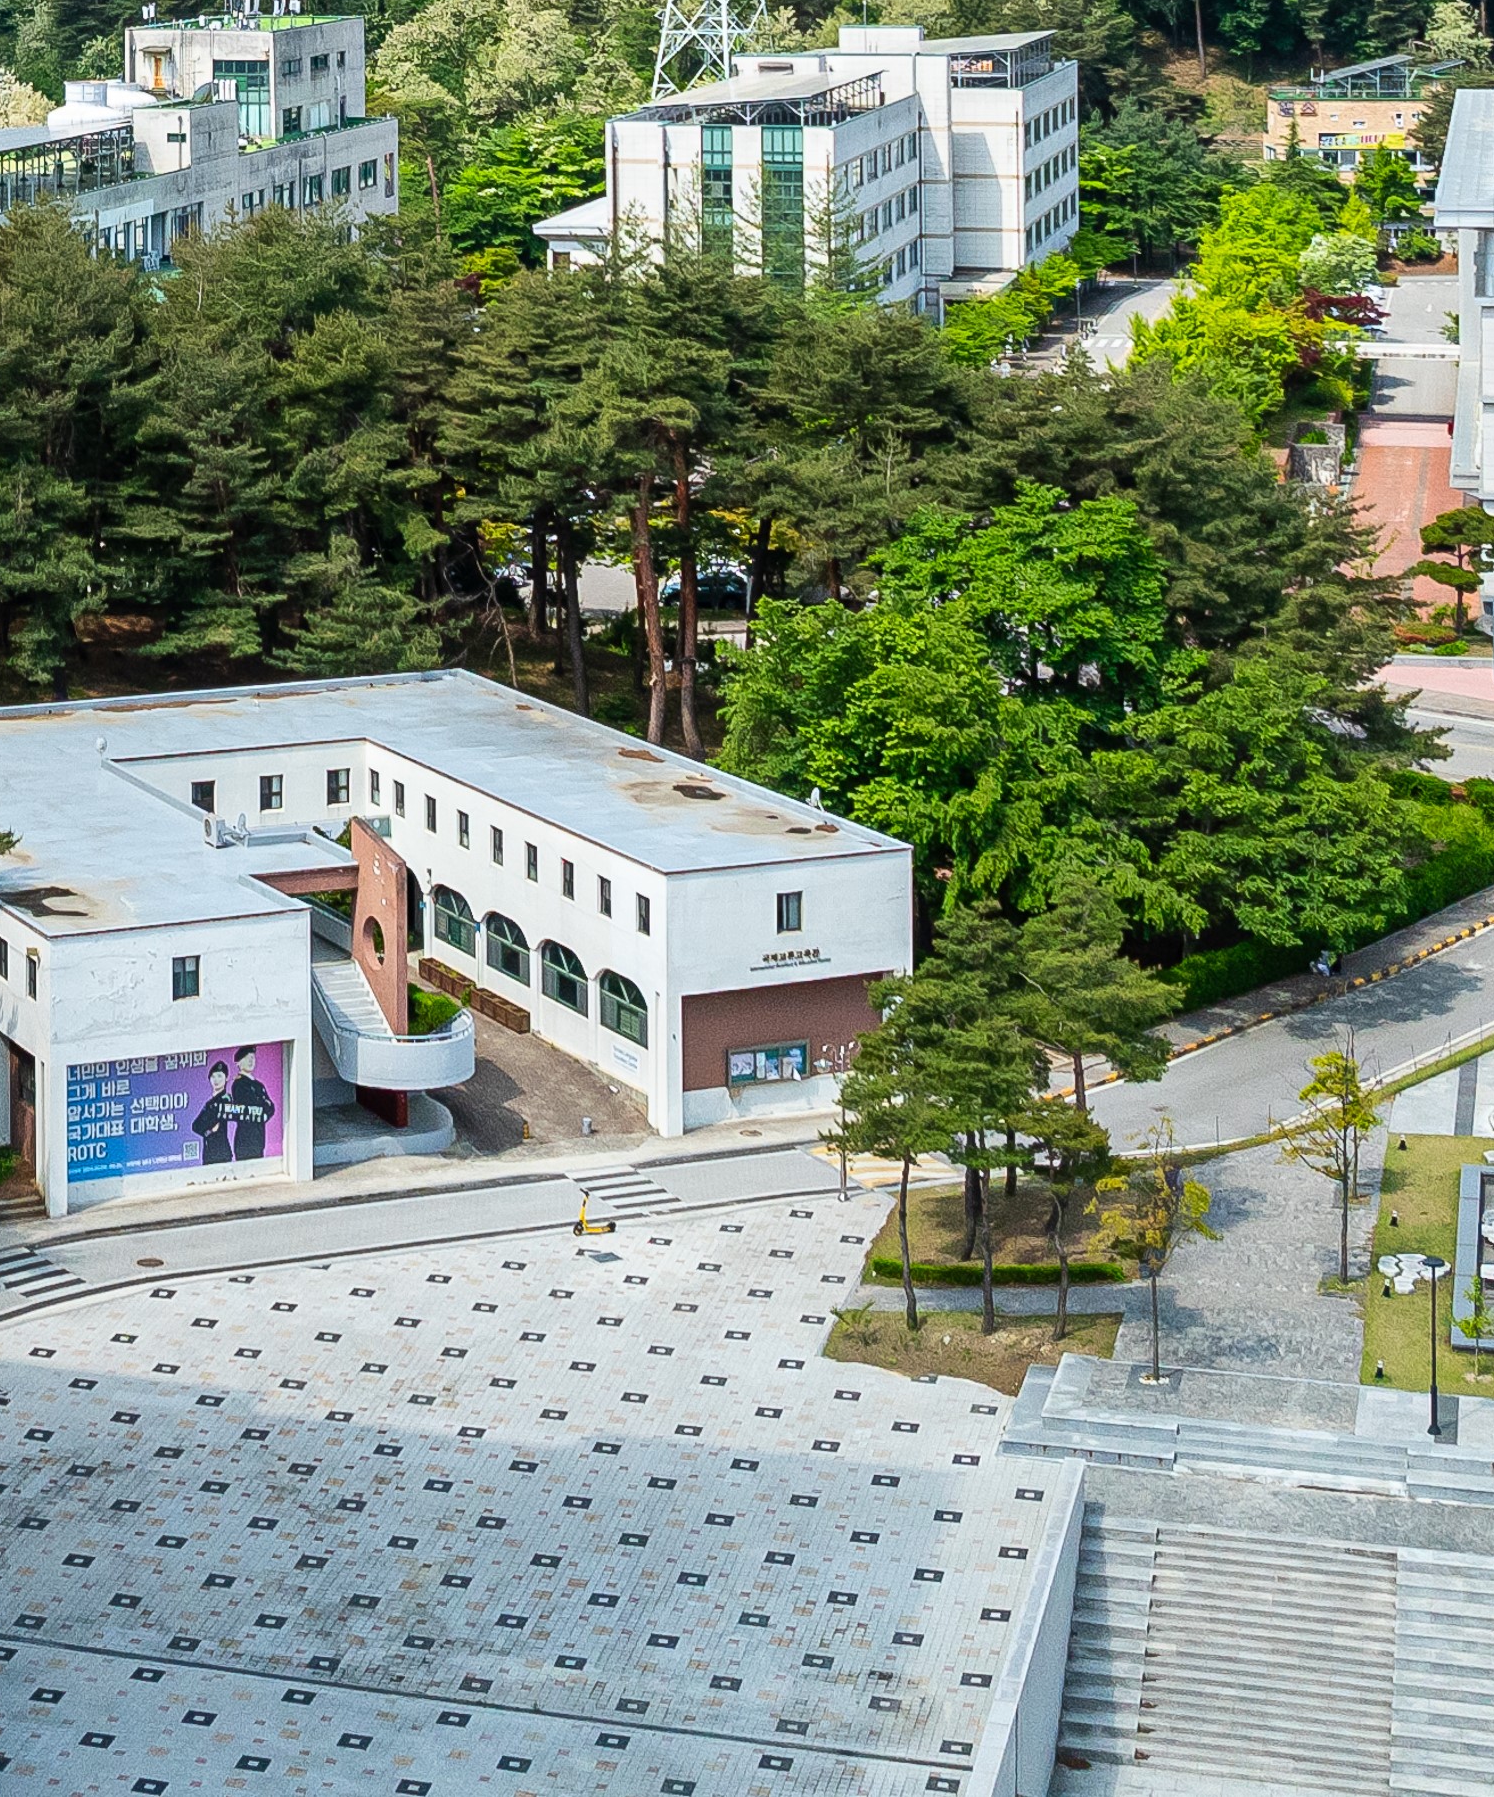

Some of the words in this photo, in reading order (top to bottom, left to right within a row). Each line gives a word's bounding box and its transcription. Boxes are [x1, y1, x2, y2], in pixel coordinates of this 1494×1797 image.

[67, 1062, 110, 1081] 너만의
[115, 1056, 158, 1076] 인생을
[67, 1082, 96, 1102] 그게
[101, 1079, 130, 1098] 바로
[67, 1101, 125, 1122] 앞서가는
[130, 1092, 188, 1115] 선택이야
[67, 1121, 125, 1142] 국가대표
[130, 1113, 178, 1134] 대학생,
[67, 1142, 107, 1163] ROTC
